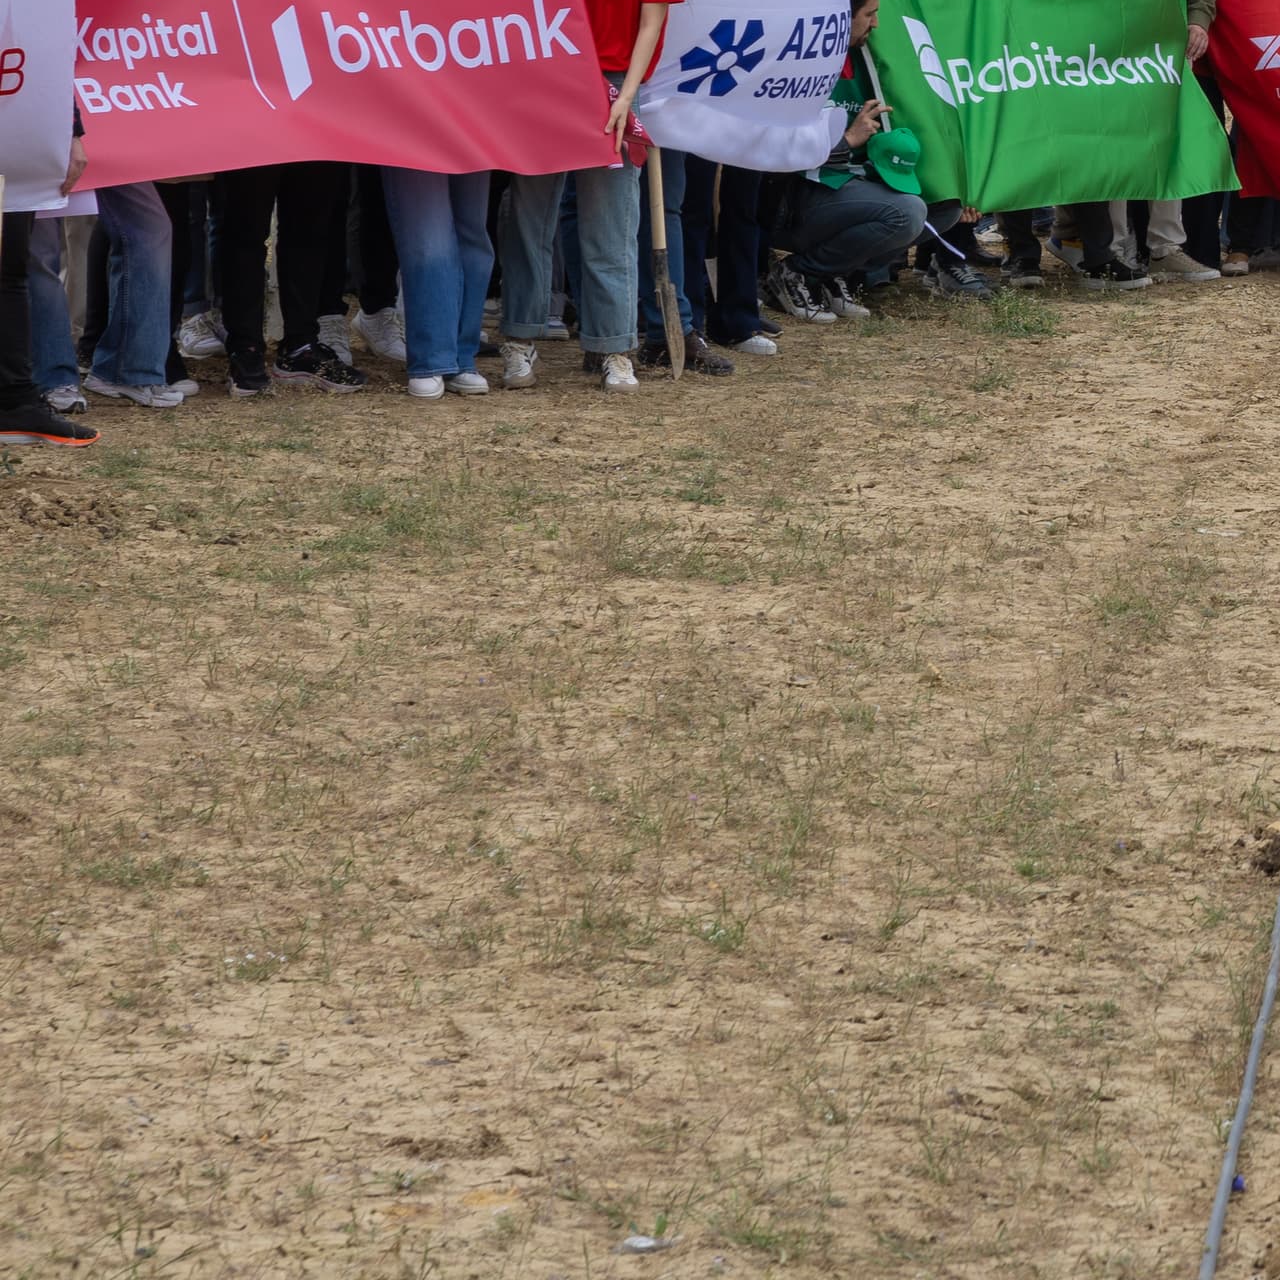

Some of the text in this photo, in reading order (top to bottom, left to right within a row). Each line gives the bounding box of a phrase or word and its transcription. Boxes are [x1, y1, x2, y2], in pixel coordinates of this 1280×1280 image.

[75, 11, 218, 70] Kapital
[74, 72, 199, 114] Bank
[946, 41, 1182, 104] Rabitabank
